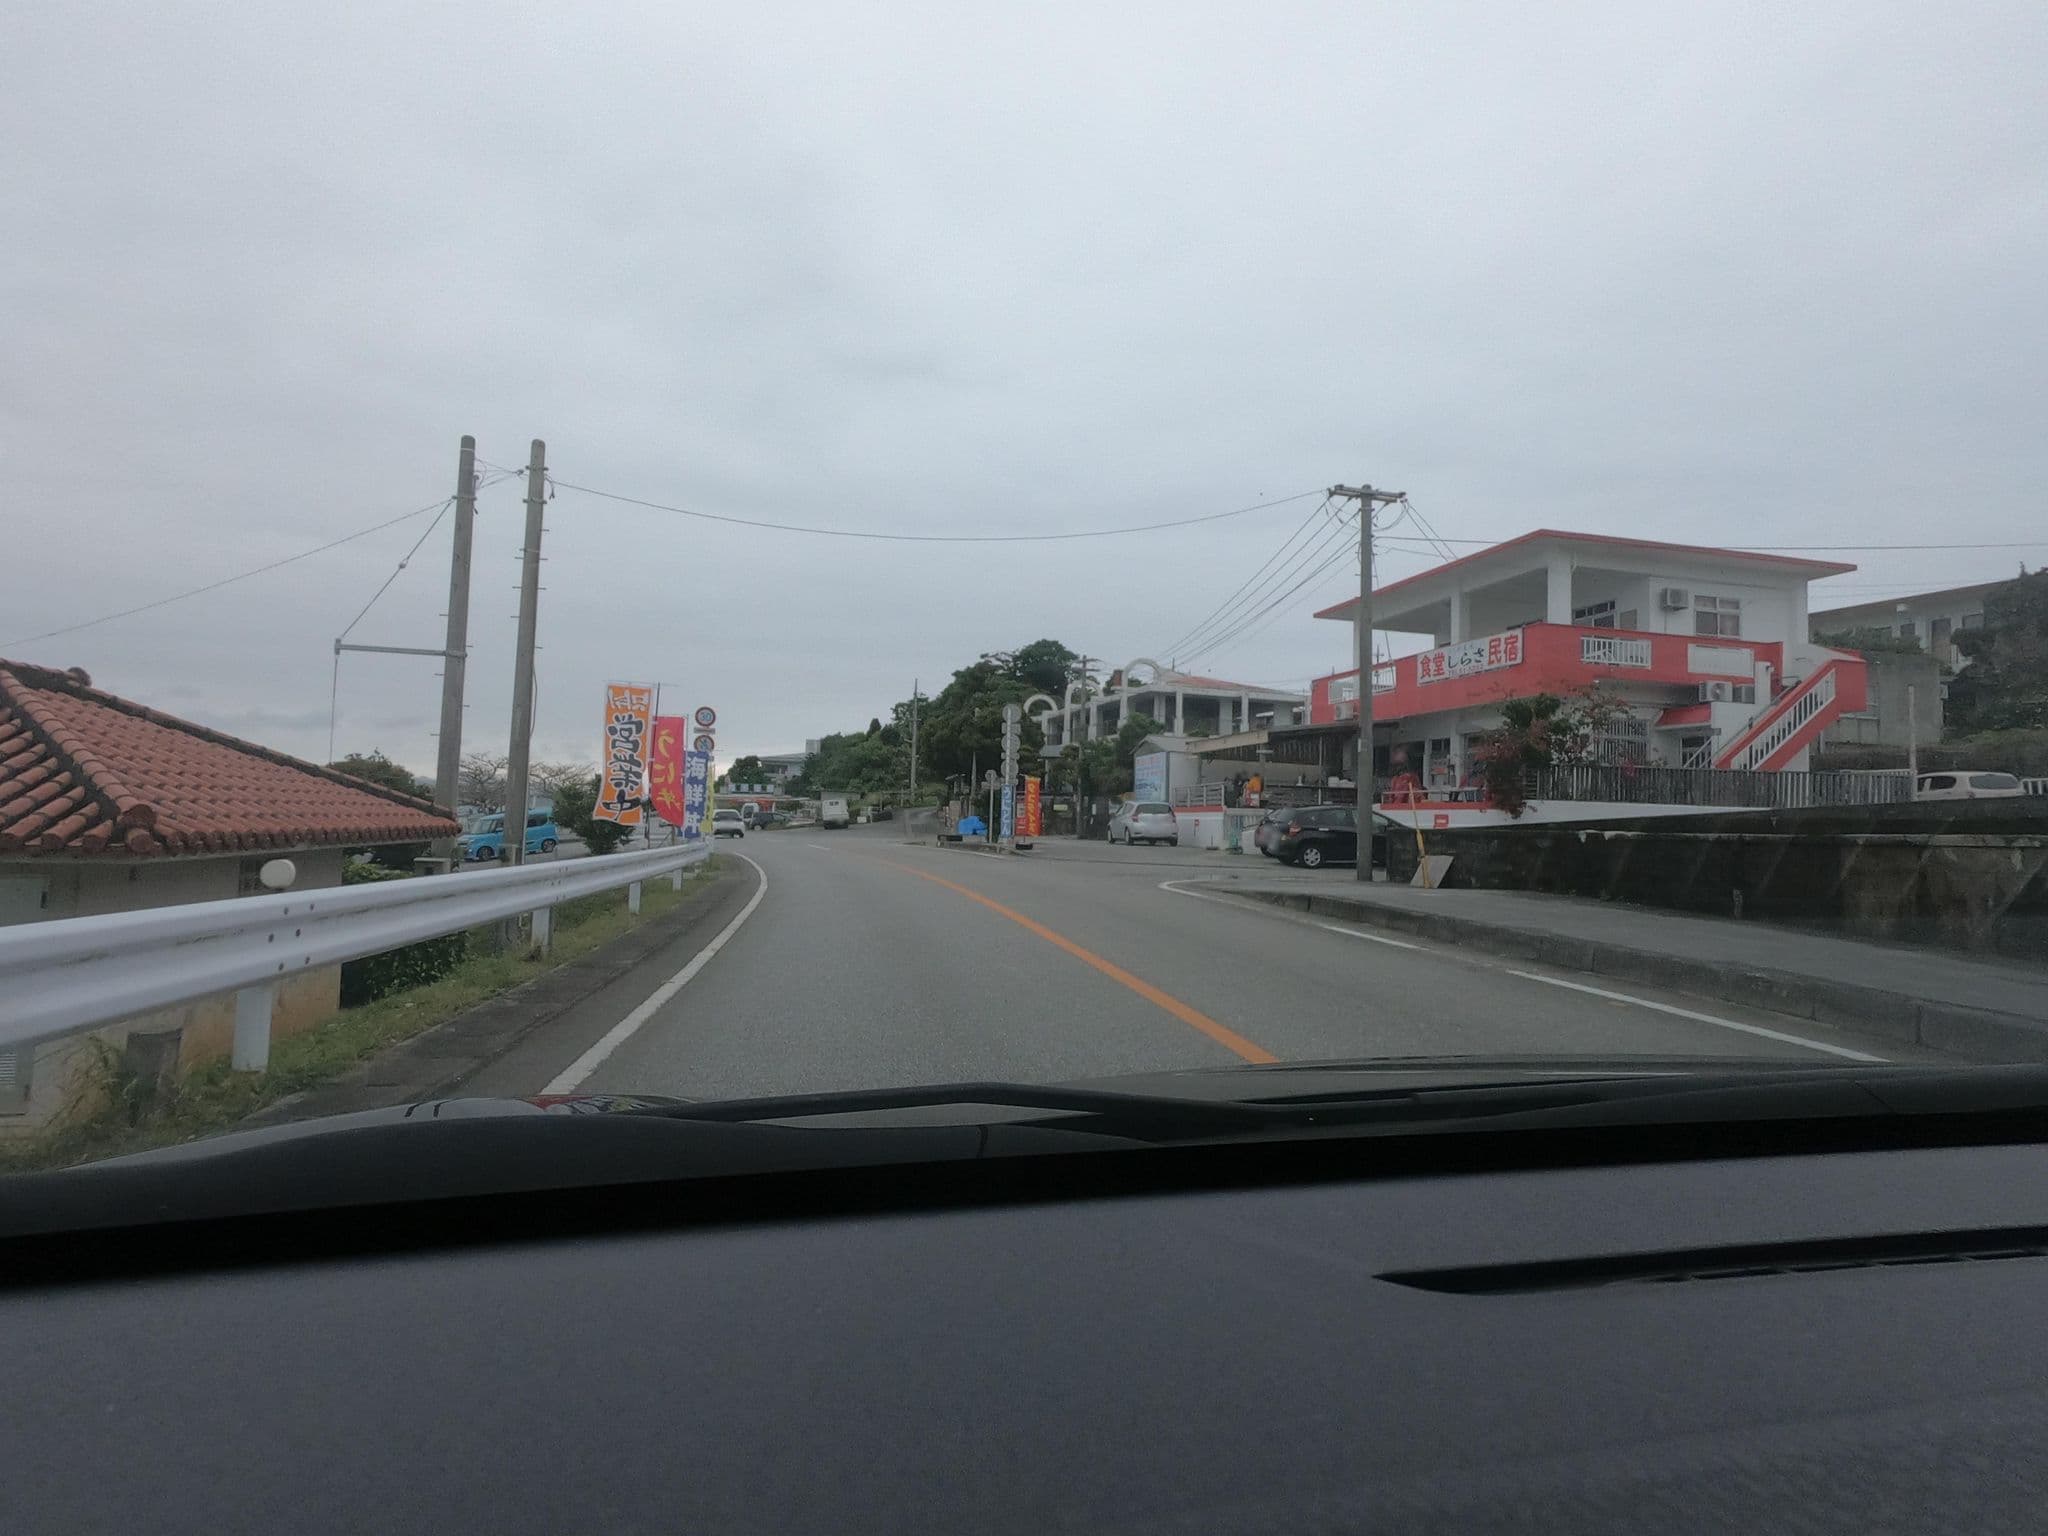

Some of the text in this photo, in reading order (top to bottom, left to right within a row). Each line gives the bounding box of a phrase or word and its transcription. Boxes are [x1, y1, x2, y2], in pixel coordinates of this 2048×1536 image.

[1420, 653, 1445, 679] 食堂
[1447, 647, 1484, 669] しらさ
[1487, 633, 1519, 665] 民宿
[686, 756, 706, 834] 海鮮丼
